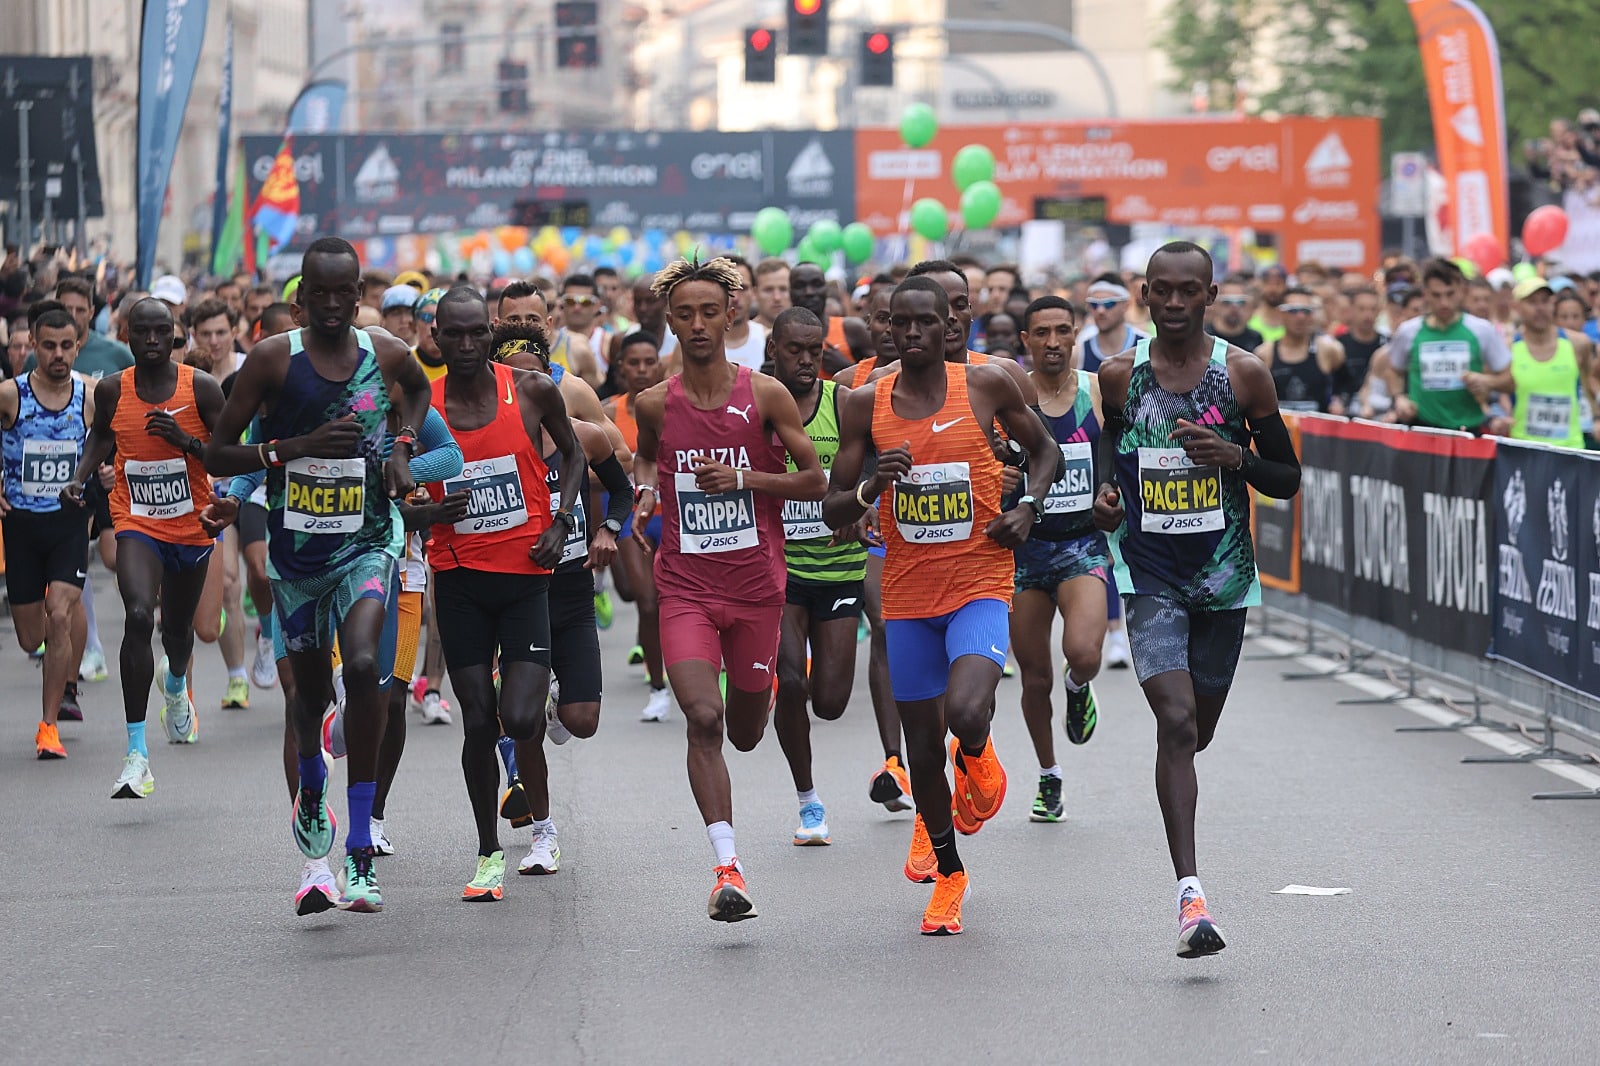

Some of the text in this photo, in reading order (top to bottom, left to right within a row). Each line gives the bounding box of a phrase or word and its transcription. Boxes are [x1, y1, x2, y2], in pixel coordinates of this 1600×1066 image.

[691, 150, 761, 181] enel
[1044, 157, 1168, 179] MARATHON
[1206, 144, 1278, 174] enel
[445, 164, 657, 188] MILANO MARATHON
[31, 460, 70, 482] 198
[141, 463, 168, 474] enel
[308, 463, 344, 477] enel
[462, 461, 497, 478] enel
[911, 467, 948, 483] enel
[132, 478, 187, 504] KWEMOI
[287, 481, 362, 513] PACE M1
[467, 482, 523, 516] UMBA B.
[1144, 477, 1218, 511] PACE M2
[157, 506, 178, 516] asics
[684, 498, 751, 531] CRIPPA
[898, 491, 969, 523] PACE M3
[1055, 499, 1077, 509] asics
[316, 520, 343, 529] asics
[485, 516, 509, 528] asics
[798, 525, 820, 534] asics
[927, 527, 954, 538] asics
[1175, 517, 1203, 529] asics
[712, 535, 739, 547] asics
[1350, 475, 1410, 594] TOYOTA
[1423, 492, 1488, 615] TOYOTA
